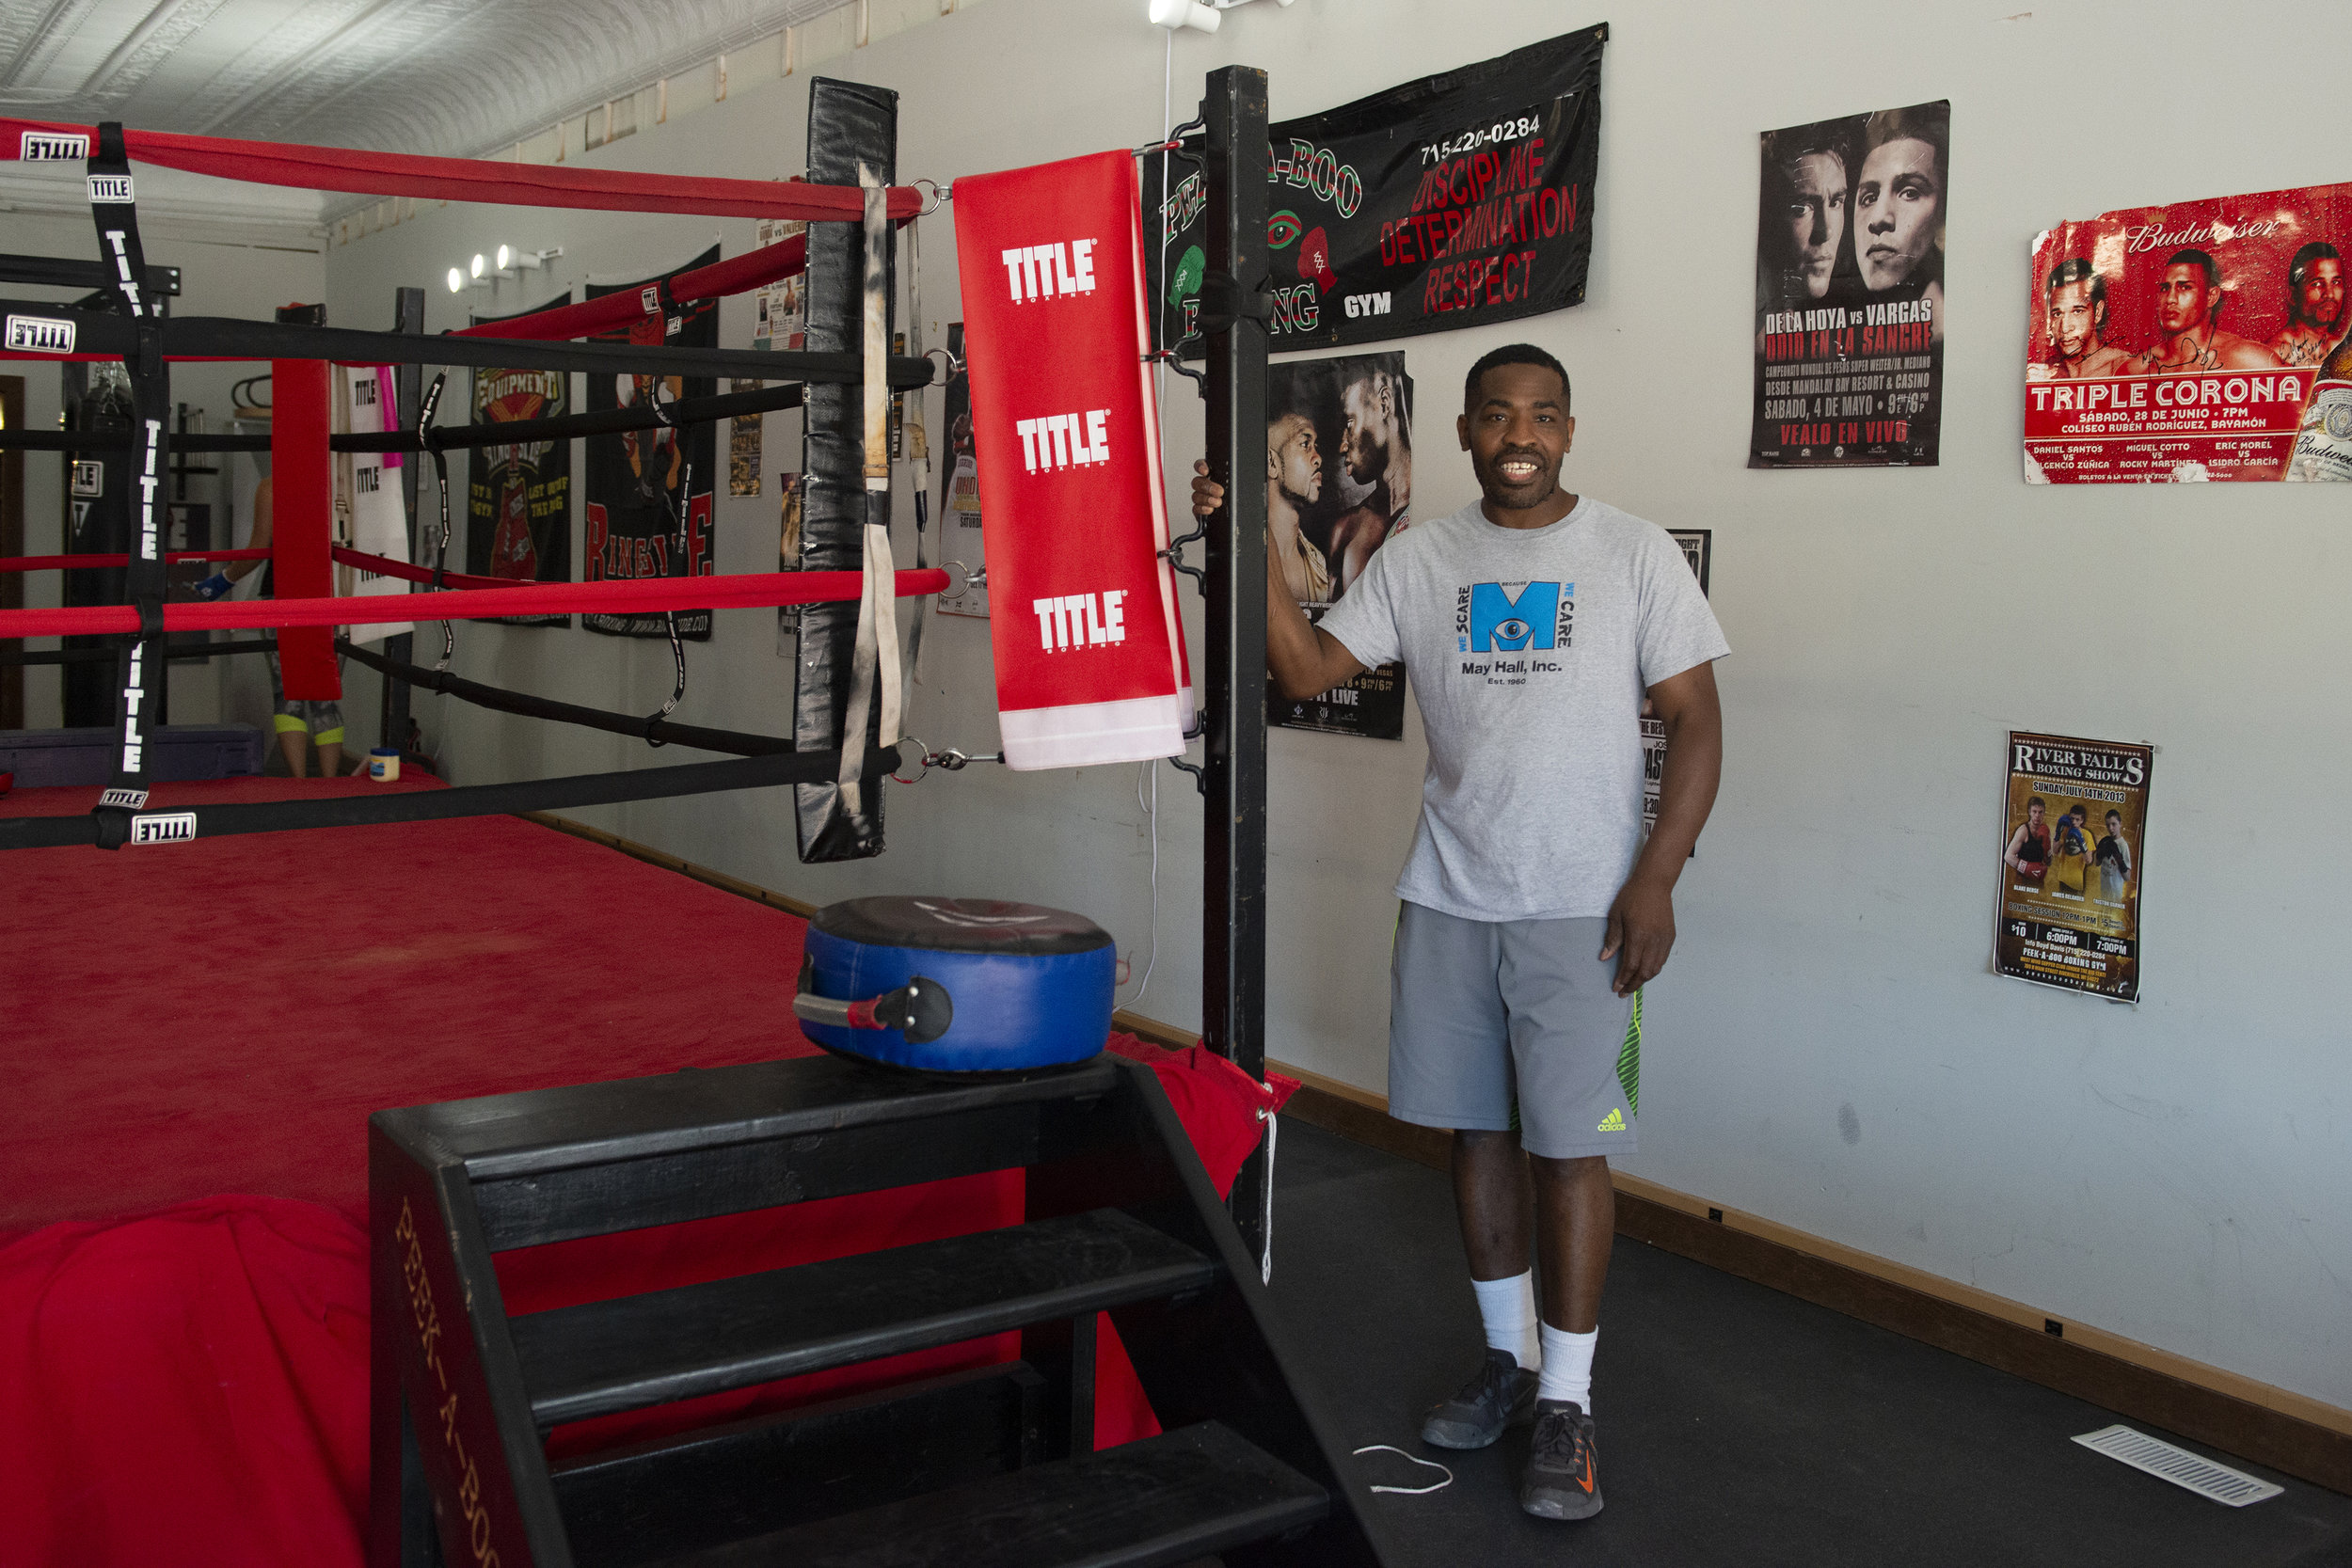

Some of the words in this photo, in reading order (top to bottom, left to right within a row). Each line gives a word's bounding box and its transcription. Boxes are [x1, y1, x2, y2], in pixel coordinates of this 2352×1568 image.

[29, 141, 80, 159] TITLE
[1411, 138, 1544, 213] DISCIPLINE
[92, 180, 128, 197] TITLE
[1380, 183, 1578, 266] DETERMINATION
[2126, 219, 2280, 254] Budweiser
[1002, 239, 1096, 300] TITLE
[1424, 250, 1535, 314] RESPECT
[1344, 292, 1391, 318] GYM
[1766, 313, 1783, 334] DE
[1787, 310, 1803, 333] LA
[1805, 308, 1846, 331] HOYA
[1851, 310, 1863, 325] VS
[1867, 299, 1931, 325] VARGAS
[15, 324, 68, 348] TITLE
[1767, 331, 1804, 362] ODIO
[1811, 329, 1830, 358] EN
[1863, 321, 1932, 356] SANGRE
[1825, 361, 1833, 373] DE
[1851, 359, 1868, 372] SUPER
[1904, 356, 1931, 369] MEDIANO
[479, 372, 553, 407] EQUIPMENT
[1765, 381, 1790, 396] DESDE
[1792, 378, 1833, 395] MANDALAY
[1836, 377, 1851, 392] BAY
[1851, 375, 1884, 391] RESORT
[1896, 372, 1930, 388] CASINO
[2031, 383, 2148, 411] TRIPLE
[2155, 375, 2301, 406] CORONA
[1765, 399, 1810, 420] SABADO,
[1814, 398, 1821, 418] 4
[1825, 396, 1838, 417] DE
[1842, 395, 1872, 417] MAYO
[2079, 411, 2130, 422] SÁBADO,
[2135, 412, 2147, 420] 28
[2153, 410, 2167, 420] DE
[2170, 409, 2209, 420] JUNIO
[2222, 407, 2249, 418] 7PM
[1781, 423, 1831, 445] VEALO
[1838, 421, 1858, 444] EN
[1866, 420, 1907, 443] VIVO
[2061, 423, 2106, 434] COLISEO
[2108, 420, 2142, 432] RUBÉN
[2146, 419, 2207, 431] RODRÍGUEZ,
[2212, 417, 2266, 429] BAYAMÓN
[1016, 409, 1110, 471] TITLE
[2034, 446, 2064, 454] DANIEL
[2067, 445, 2104, 453] SANTOS
[2126, 444, 2157, 452] MIGUEL
[2160, 443, 2190, 451] COTTO
[2240, 441, 2272, 450] MOREL
[2077, 459, 2109, 468] ZÚÑIGA
[2244, 457, 2279, 466] GARCÍA
[139, 419, 161, 560] TITLE
[1564, 582, 1575, 597] WE
[1033, 590, 1125, 649] TITLE
[1455, 585, 1470, 634] SCARE
[1557, 600, 1574, 648] CARE
[1462, 662, 1491, 675] May
[1495, 660, 1528, 674] Hall,
[1532, 660, 1563, 672] Inc.
[1331, 688, 1359, 705] LIVE
[2013, 745, 2075, 771] RIVER
[2081, 752, 2144, 785] FALLS
[2037, 763, 2082, 778] BOXING
[106, 792, 143, 805] TITLE
[2033, 782, 2065, 796] SUNDAY,
[2066, 786, 2082, 797] JULY
[2084, 788, 2103, 800] 14TH
[2105, 791, 2125, 803] 2013
[140, 821, 190, 841] TITLE
[2009, 902, 2032, 913] BOXING
[2034, 908, 2060, 918] SESSION
[2011, 925, 2026, 937] $10
[2046, 931, 2077, 945] 6:00PM
[2025, 939, 2035, 947] Info
[2036, 941, 2049, 950] Boyd
[2050, 942, 2065, 952] Davis
[2097, 941, 2127, 955] 7:00PM
[2023, 948, 2062, 963] PEEK-A-BOO
[2064, 954, 2090, 968] BOXING
[2091, 959, 2106, 972] GYM
[1597, 1122, 1627, 1132] adidas
